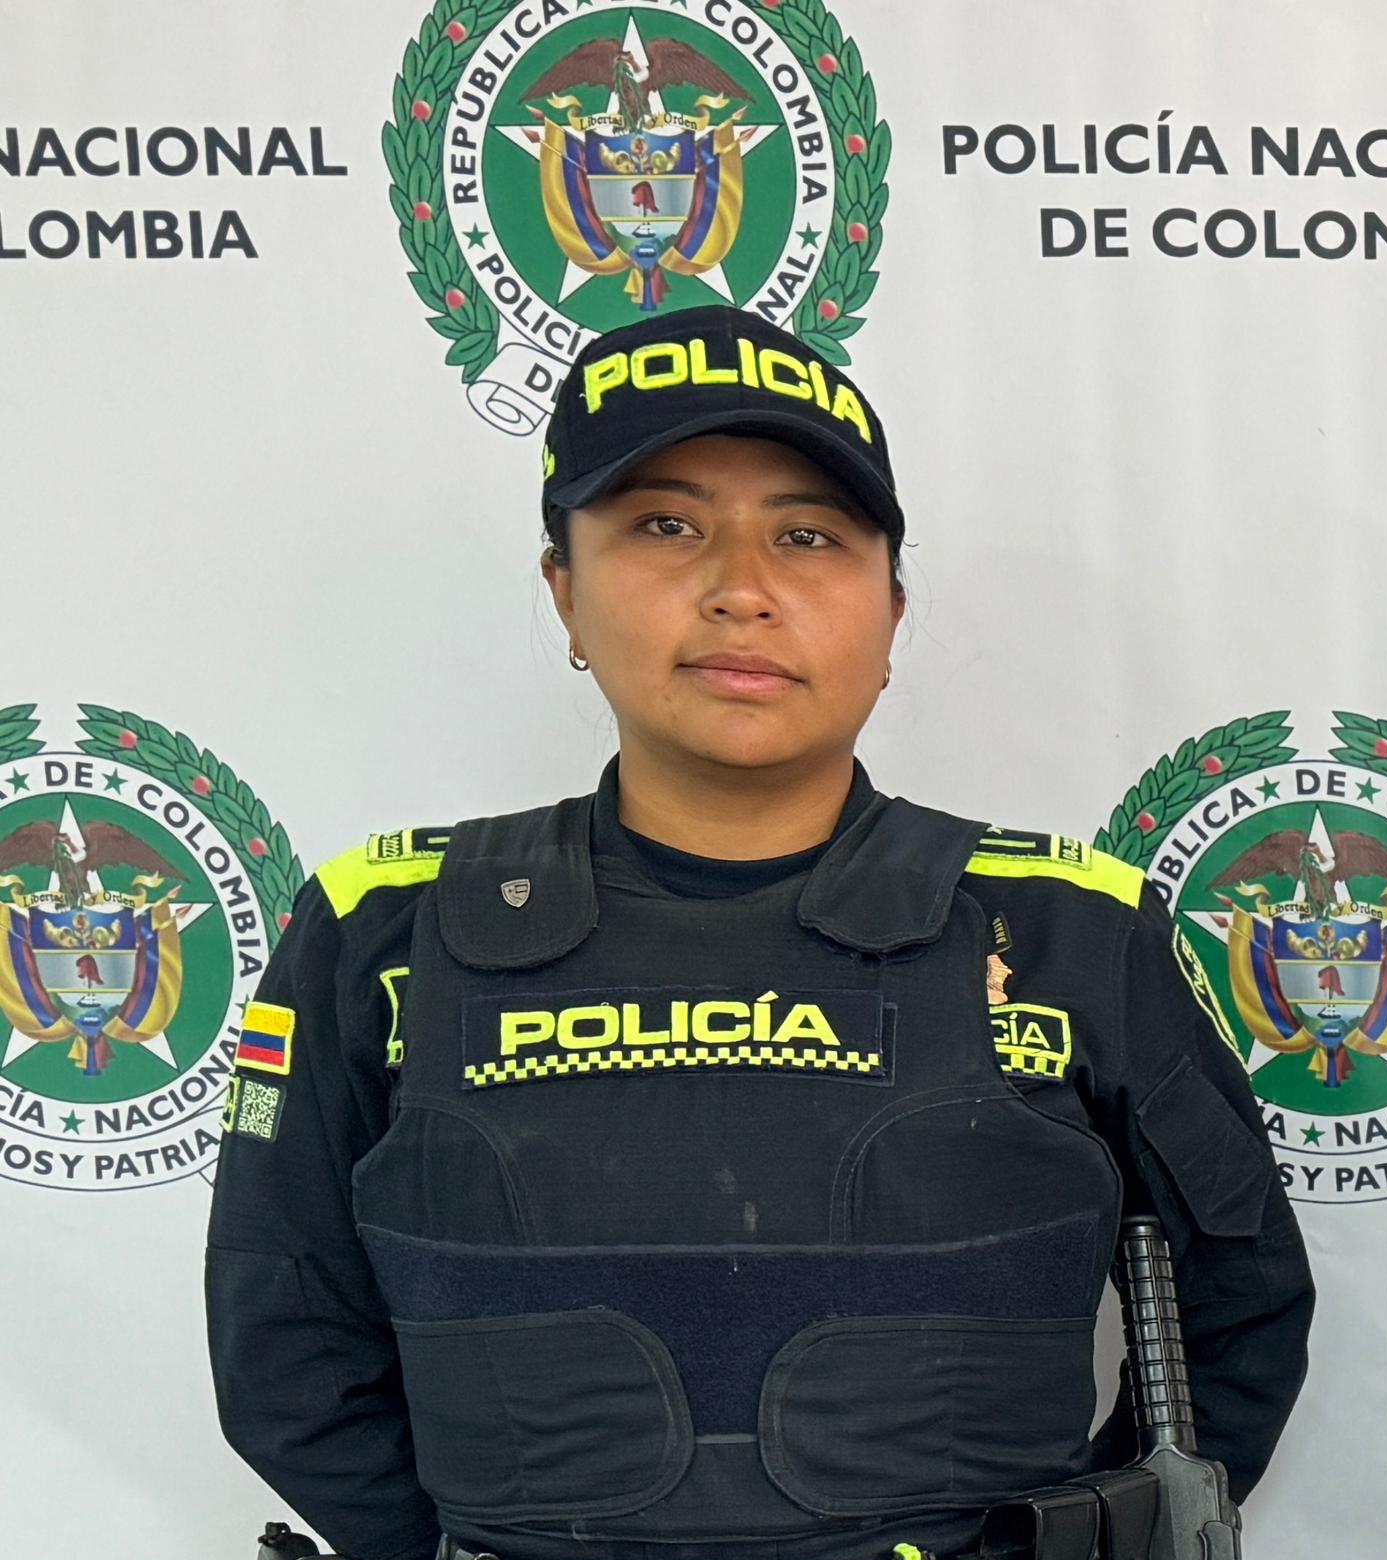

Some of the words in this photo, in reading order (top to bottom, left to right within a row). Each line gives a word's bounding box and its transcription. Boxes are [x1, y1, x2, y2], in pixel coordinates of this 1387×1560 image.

[662, 113, 699, 131] Orden
[702, 0, 829, 205] COLOMBIA
[941, 109, 1229, 176] POLICÍA
[1038, 206, 1130, 259] DE
[476, 252, 582, 358] POLICÍ
[583, 337, 873, 443] POLICÍA
[43, 759, 95, 789] DE
[1295, 768, 1348, 798] DE
[137, 783, 264, 979] COLOMBIA
[1349, 902, 1385, 920] Orden
[500, 989, 841, 1056] POLICÍA
[57, 1152, 85, 1181] Y
[93, 1128, 223, 1181] PATRIA
[1301, 1162, 1325, 1192] Y
